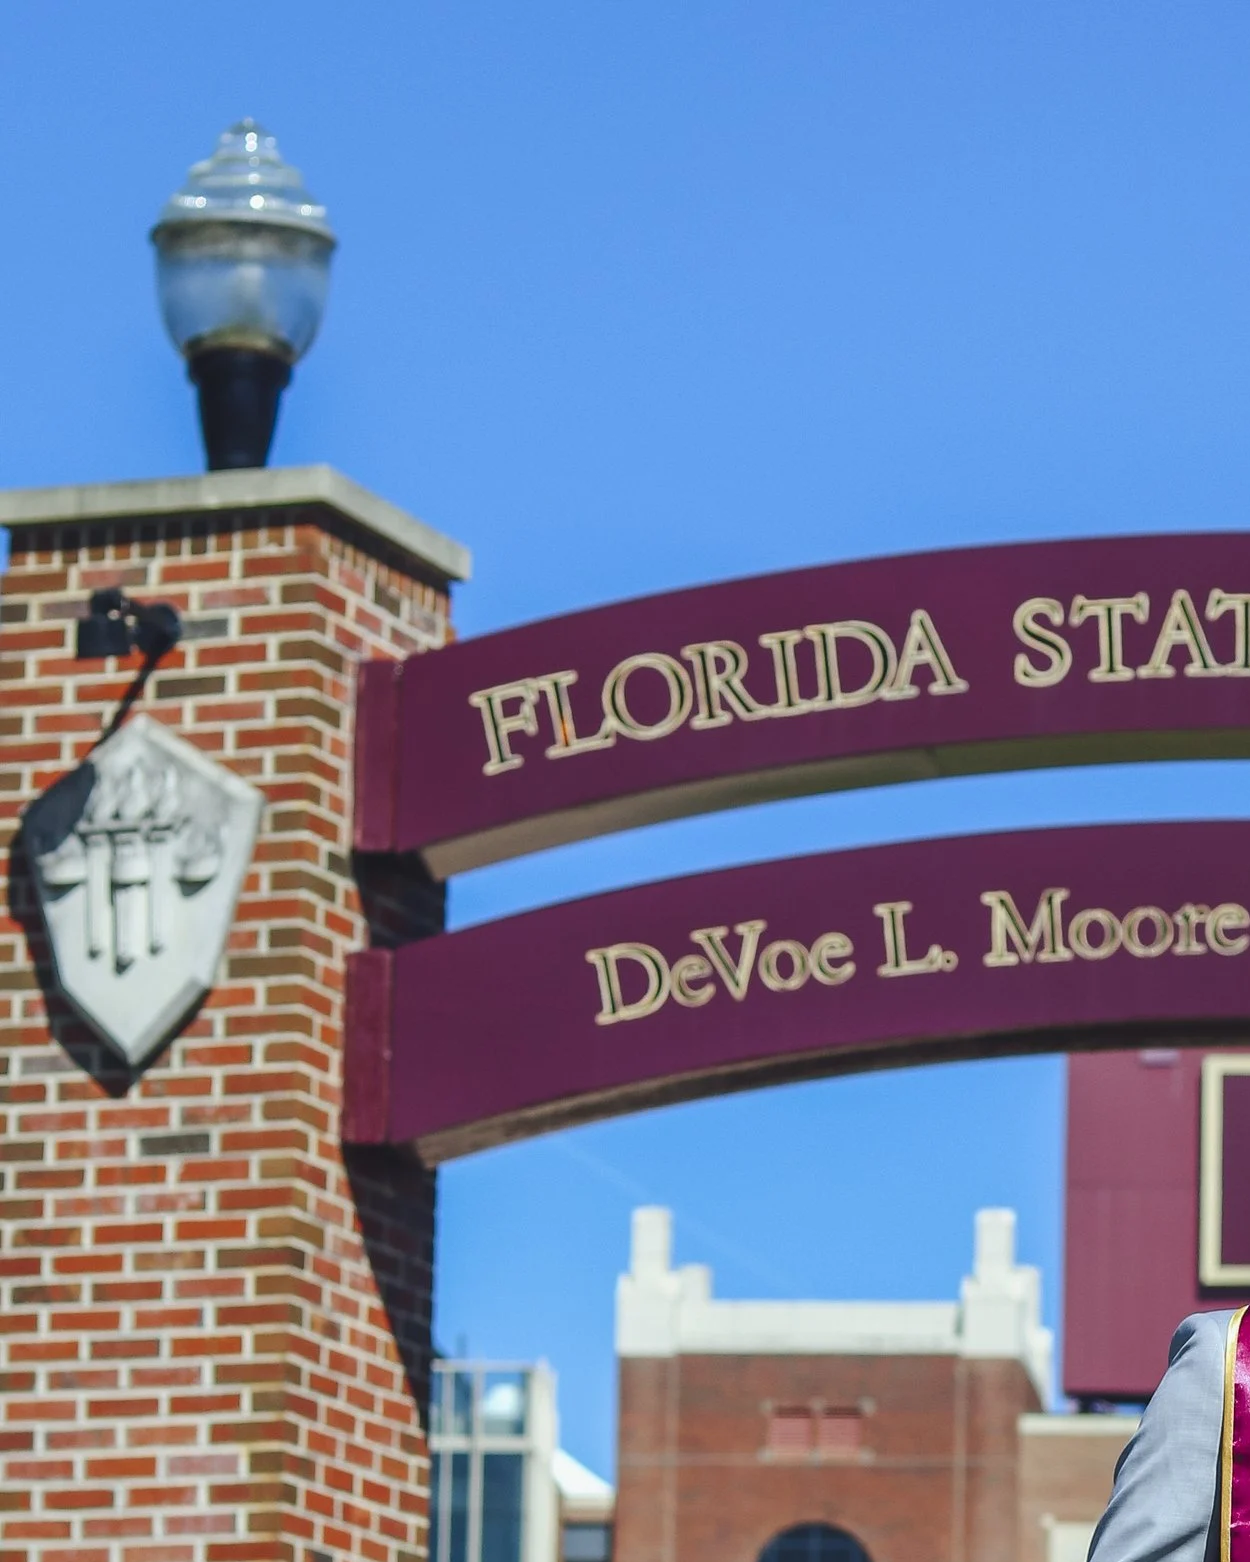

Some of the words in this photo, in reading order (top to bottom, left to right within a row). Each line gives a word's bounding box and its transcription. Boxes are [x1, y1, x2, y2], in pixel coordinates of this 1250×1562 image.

[469, 609, 969, 776] FLORIDA
[586, 920, 857, 1026] DeVoe
[874, 901, 959, 978] L.
